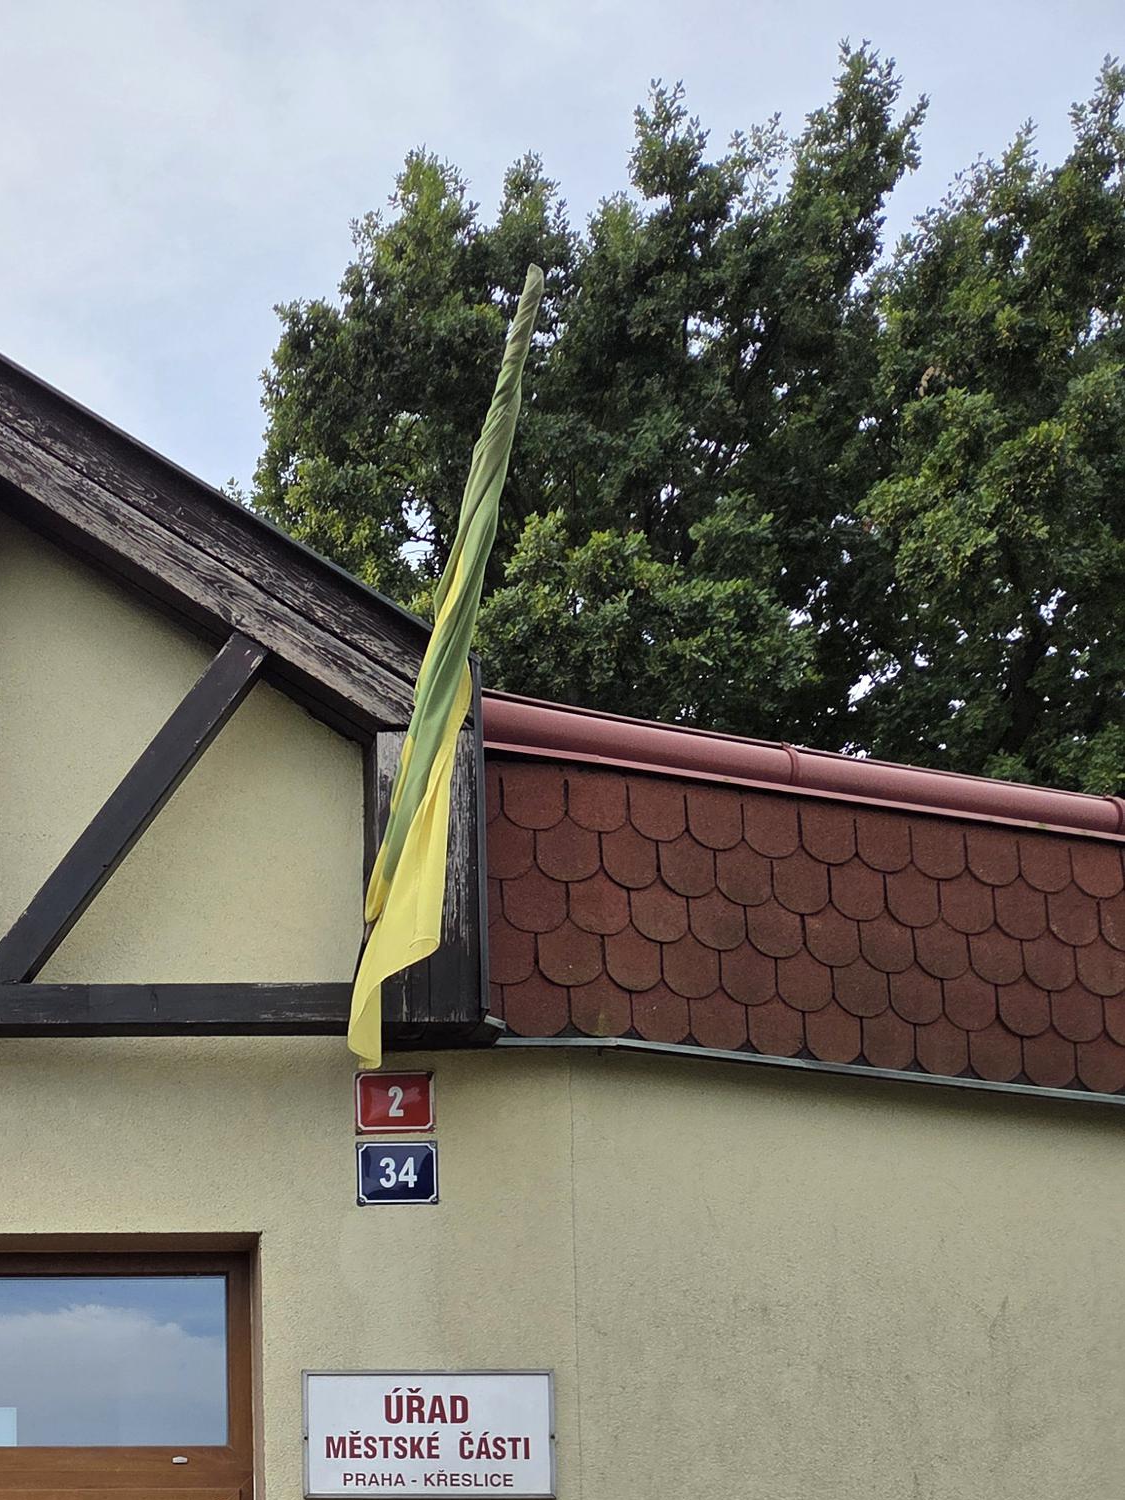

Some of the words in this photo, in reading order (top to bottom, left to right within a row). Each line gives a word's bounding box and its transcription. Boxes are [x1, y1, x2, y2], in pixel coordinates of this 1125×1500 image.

[387, 1085, 405, 1117] 2
[379, 1156, 418, 1189] 34
[384, 1387, 469, 1424] ÚŘAD
[325, 1431, 441, 1460] MĚSTSKÉ
[459, 1431, 531, 1460] ČÁSTI
[343, 1472, 406, 1487] PRAHA
[424, 1470, 515, 1488] KŘESLICE
